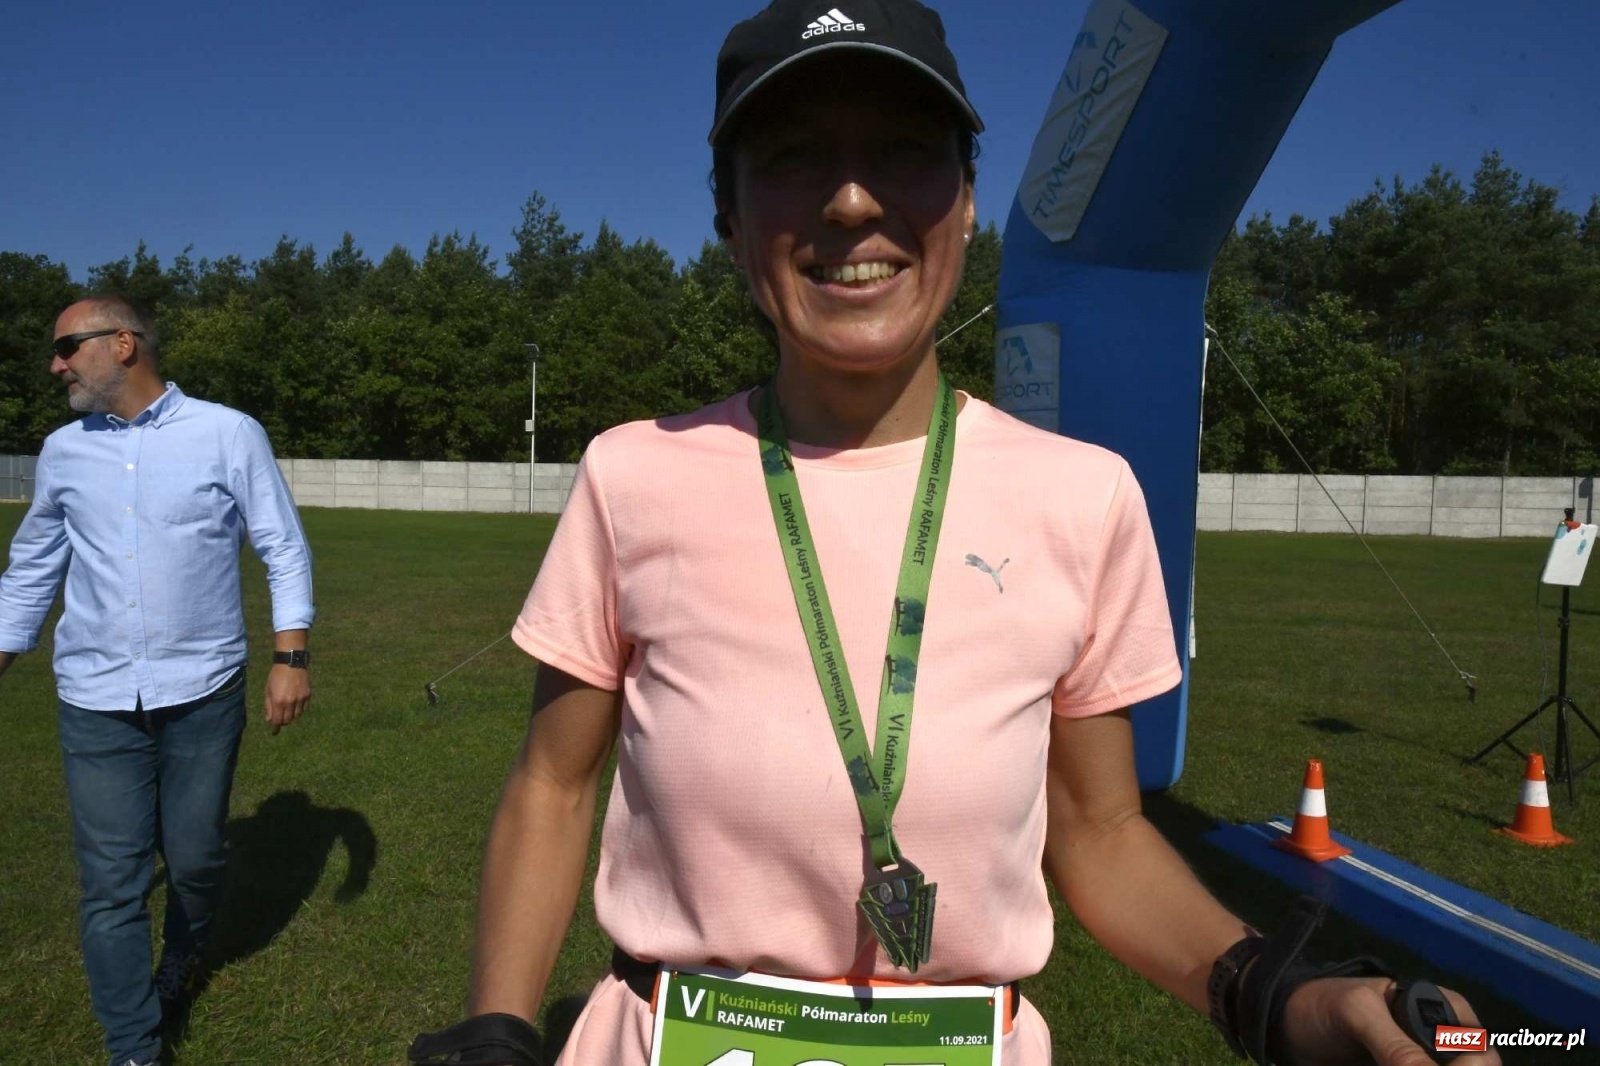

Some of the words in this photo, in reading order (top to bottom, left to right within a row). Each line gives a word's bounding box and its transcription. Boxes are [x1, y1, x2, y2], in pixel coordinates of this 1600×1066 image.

[802, 23, 866, 39] adidas
[1032, 10, 1133, 219] TIMESPORT
[926, 477, 940, 507] Leśny
[778, 492, 802, 546] RAFAMET
[912, 508, 934, 566] RAFAMET
[795, 547, 812, 580] Leśny
[805, 581, 831, 650] Półmaraton
[822, 651, 851, 717] Kuźniański
[888, 713, 905, 732] VI
[717, 1010, 785, 1033] RAFAMET
[719, 992, 798, 1016] Kuźniański
[801, 1005, 888, 1024] Półmaraton
[891, 1010, 930, 1026] Leśny
[939, 1035, 988, 1046] 11.09.2021
